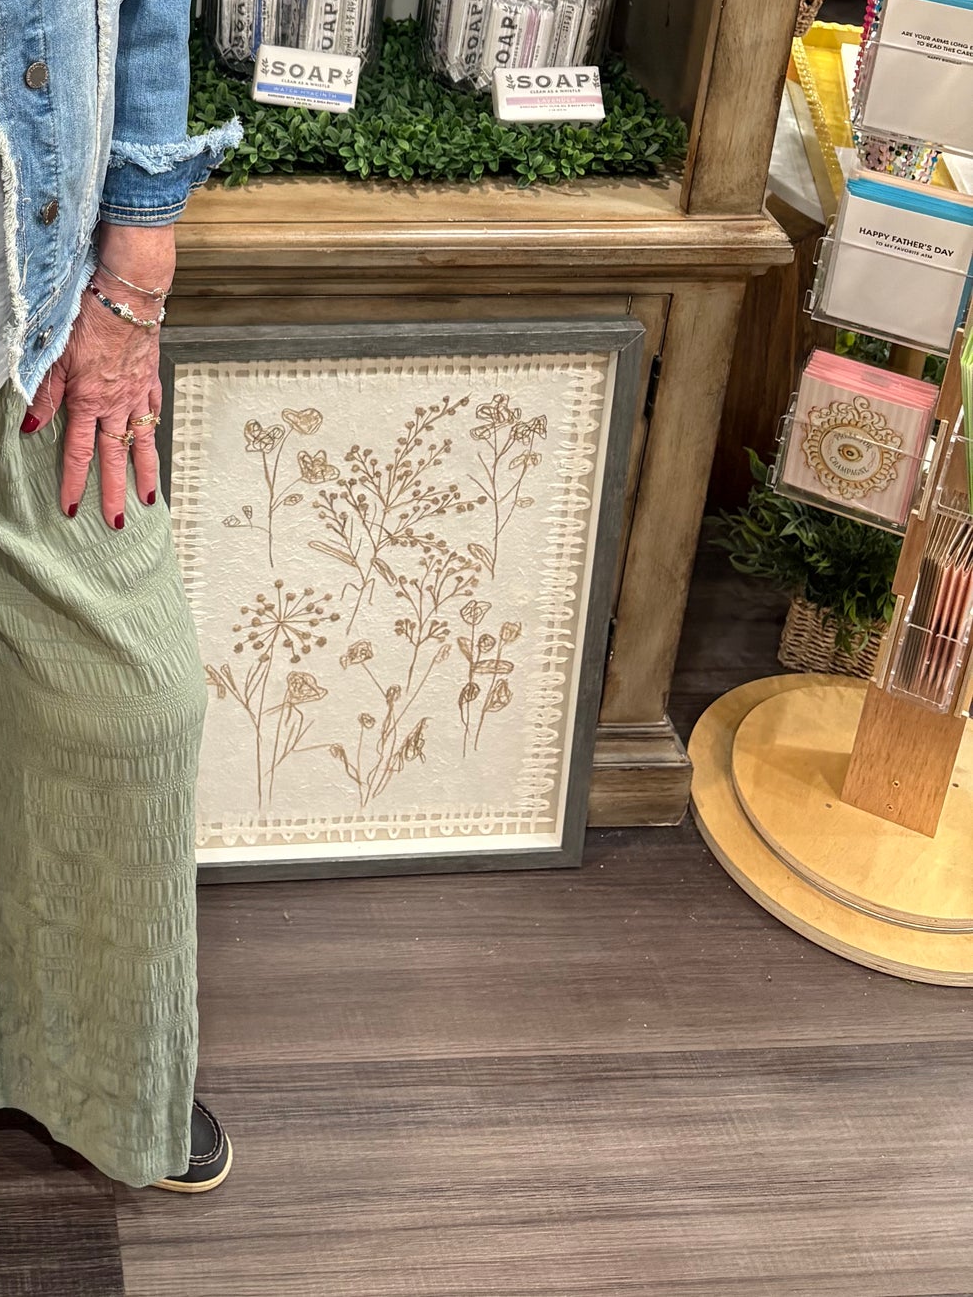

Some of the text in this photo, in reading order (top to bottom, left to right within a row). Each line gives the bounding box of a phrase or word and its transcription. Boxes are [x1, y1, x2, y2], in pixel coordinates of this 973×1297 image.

[321, 3, 338, 53] OAP
[465, 4, 484, 66] SOAP
[495, 15, 518, 69] OAP
[915, 33, 931, 41] YOUR
[932, 37, 949, 45] ARMS
[950, 41, 968, 49] LONG
[270, 60, 343, 84] SOAP
[516, 73, 591, 89] SOAP
[300, 89, 337, 99] HYACINTH
[858, 227, 955, 257] HAPPY FATHER'S DAY
[894, 246, 919, 256] FAVORITE
[829, 456, 869, 476] CHAMPAGNE
